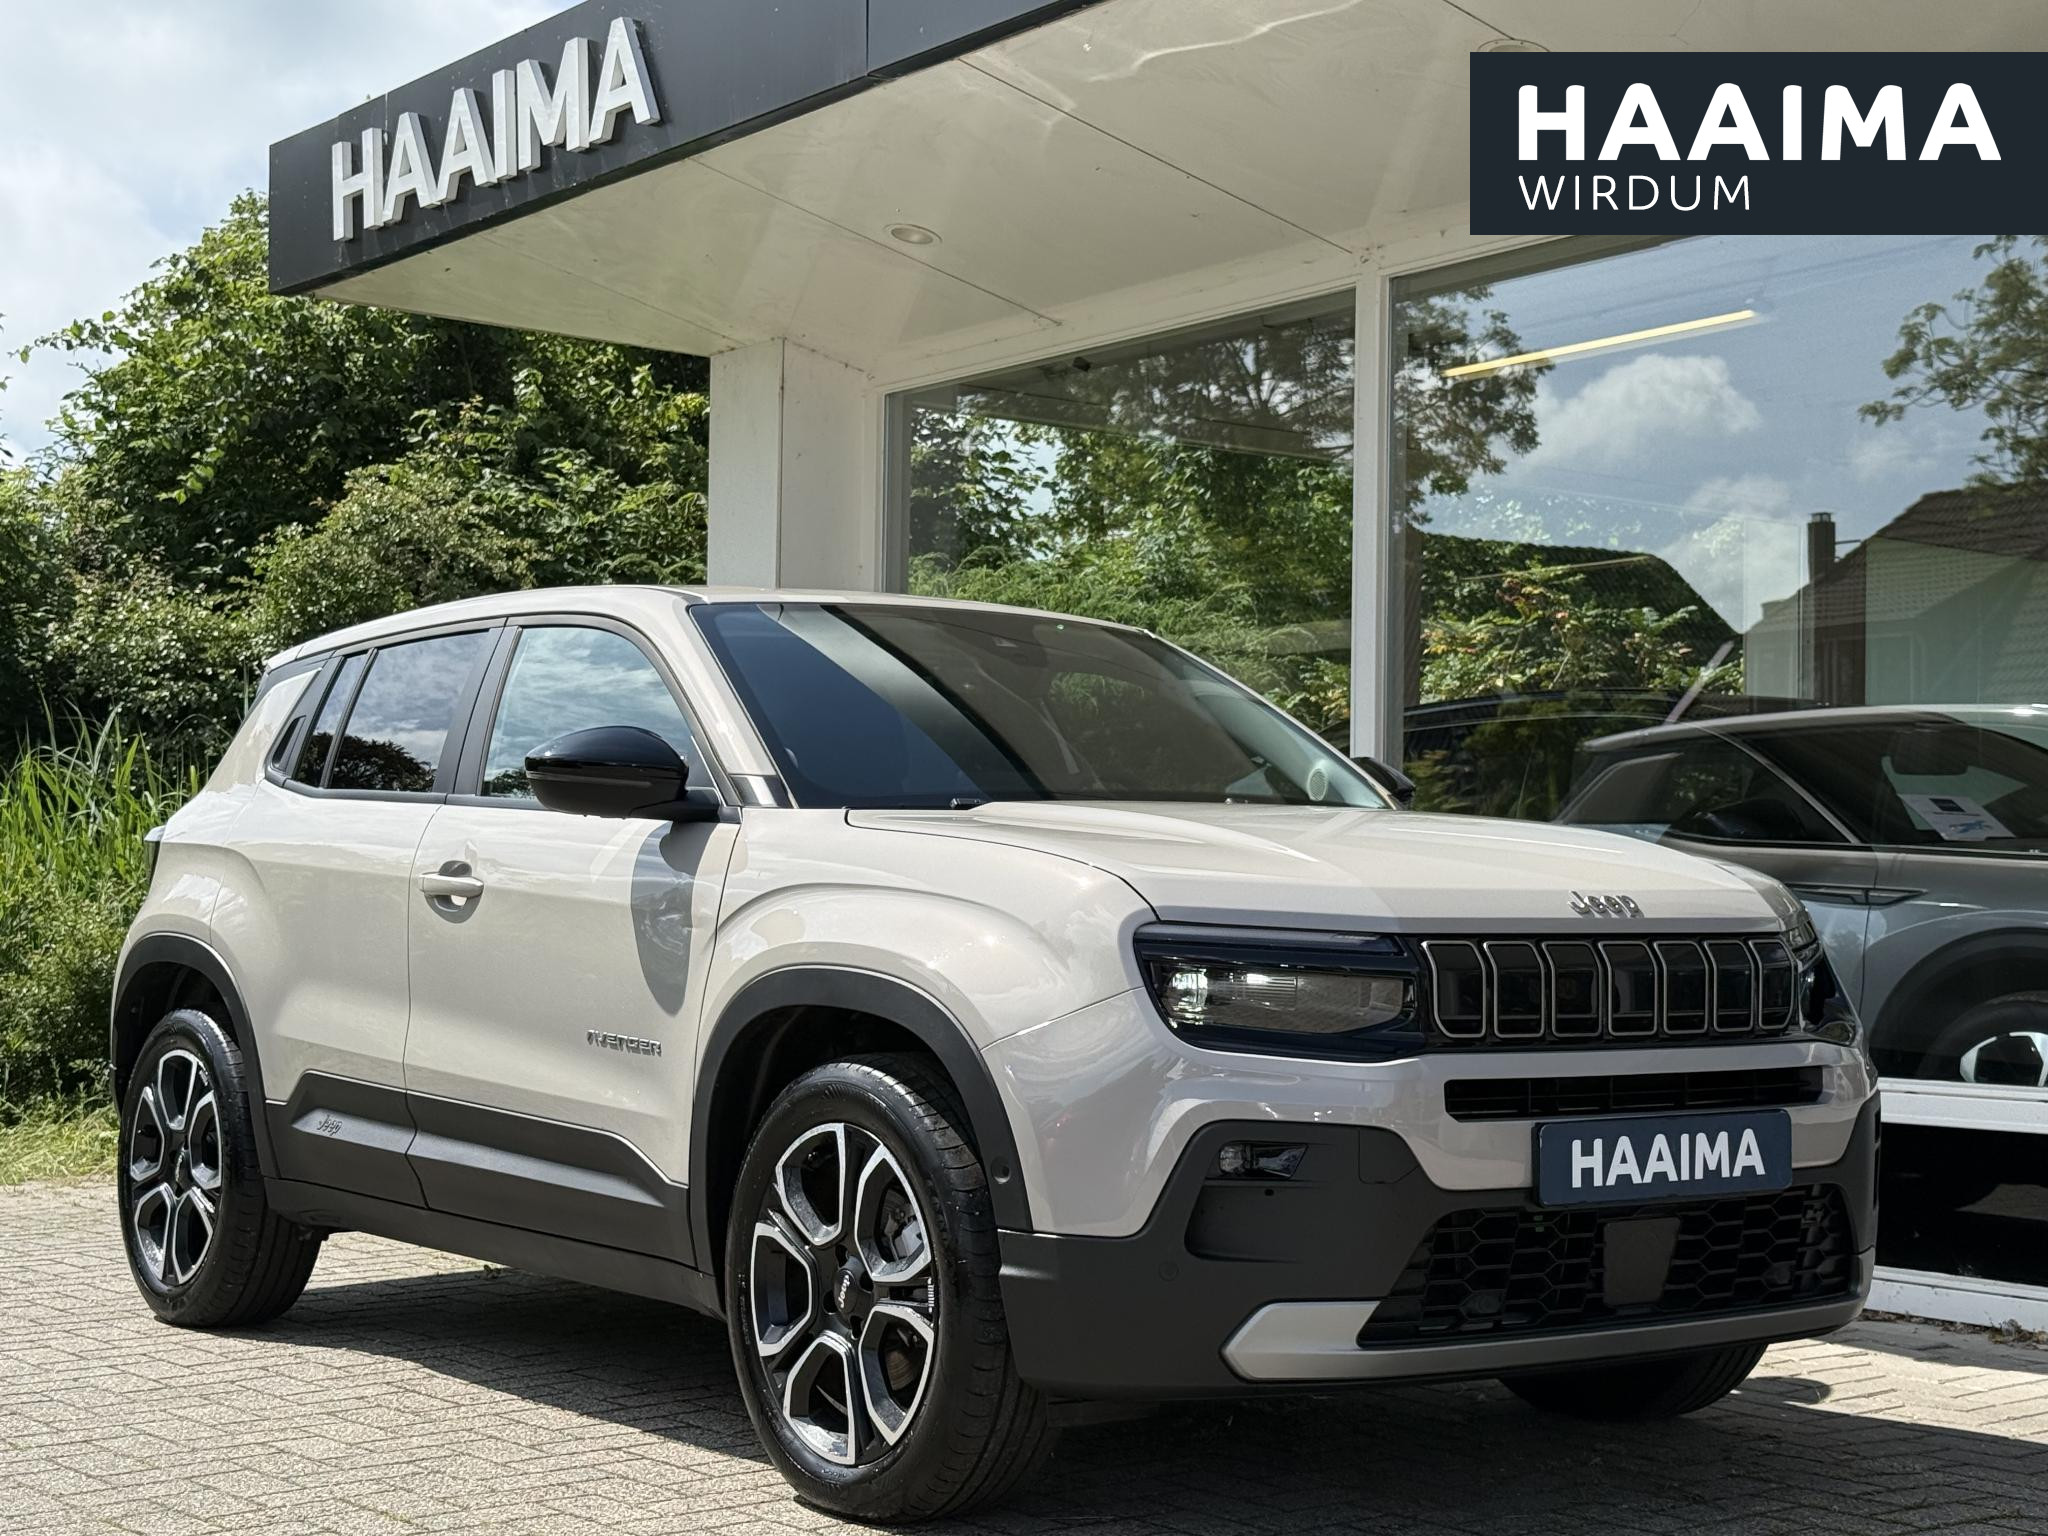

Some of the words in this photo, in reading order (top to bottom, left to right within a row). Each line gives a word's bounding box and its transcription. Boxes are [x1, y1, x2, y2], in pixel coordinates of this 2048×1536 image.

[332, 17, 660, 241] HAAIMA
[1567, 889, 1644, 918] Jeep
[1572, 1128, 1766, 1188] HAAIMA
